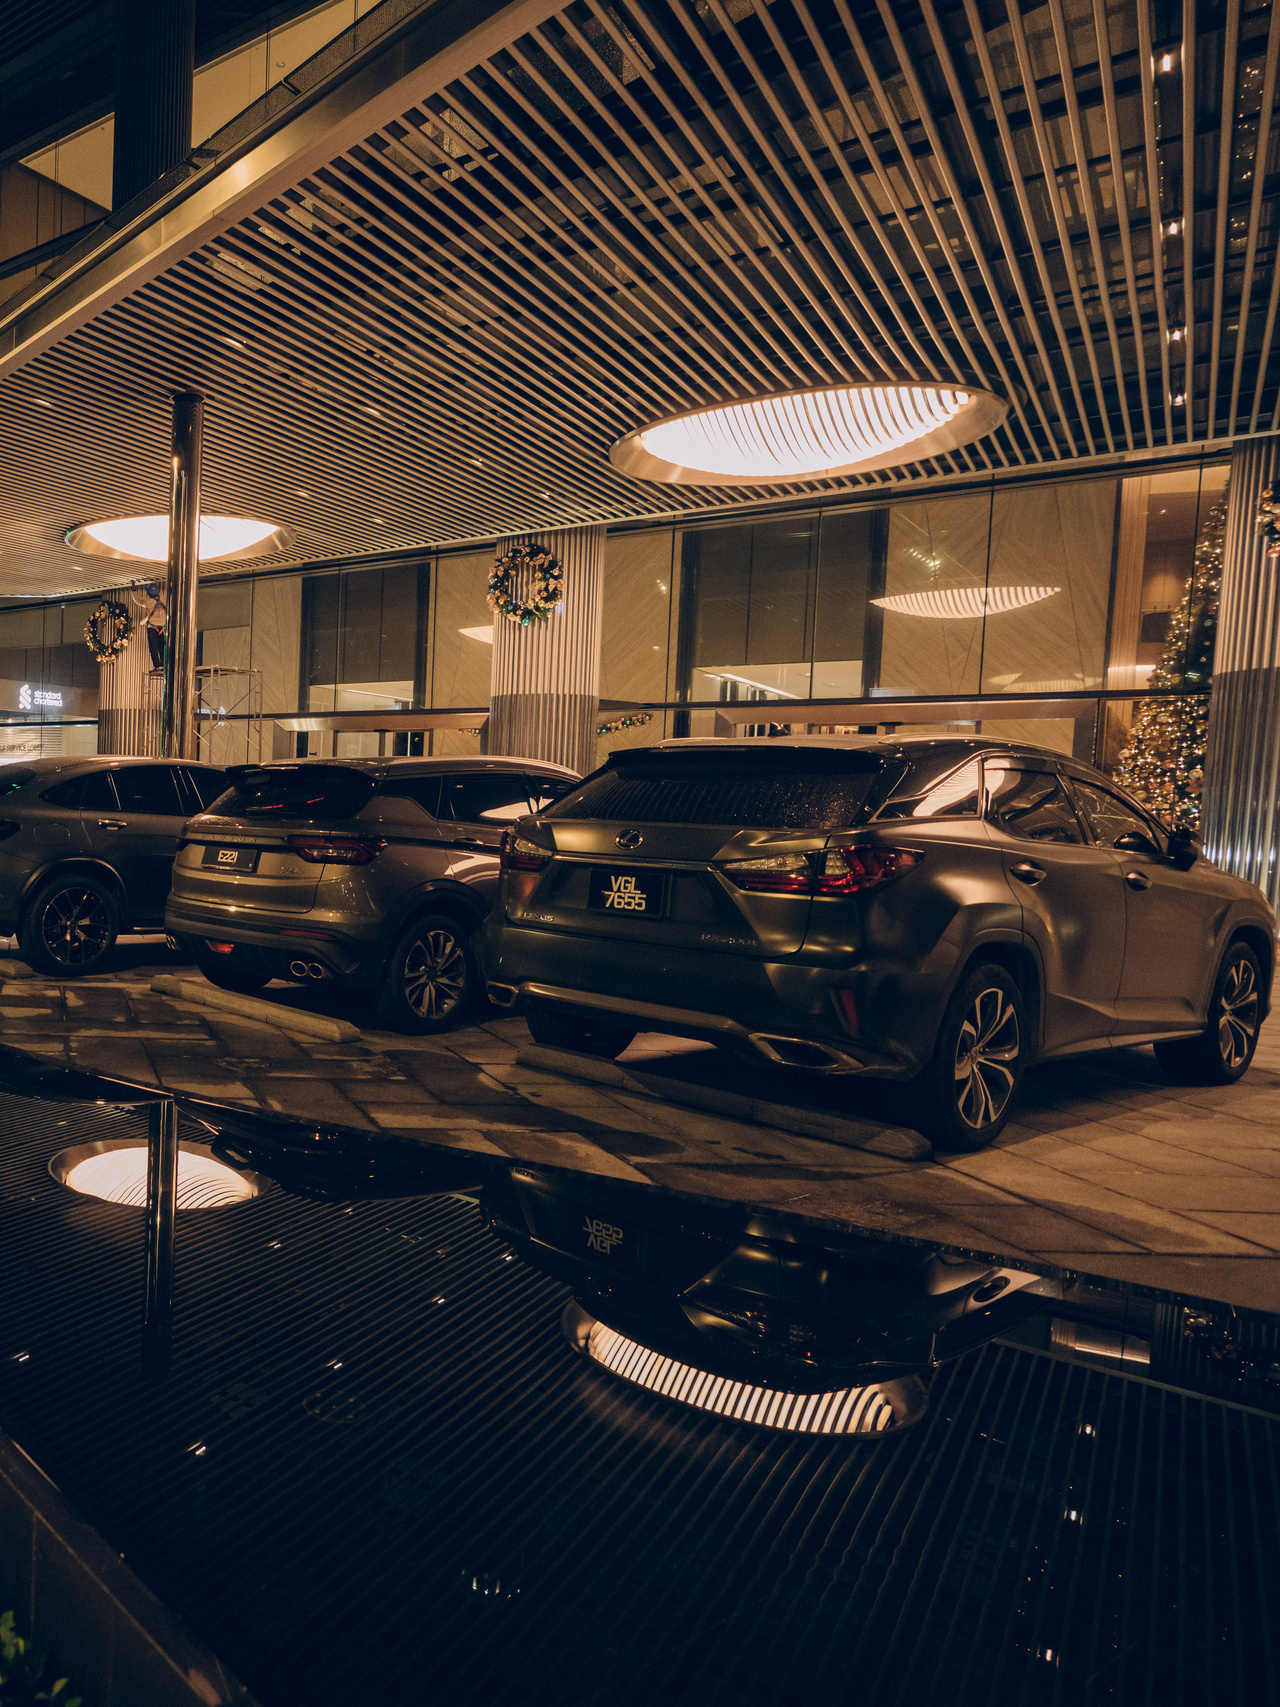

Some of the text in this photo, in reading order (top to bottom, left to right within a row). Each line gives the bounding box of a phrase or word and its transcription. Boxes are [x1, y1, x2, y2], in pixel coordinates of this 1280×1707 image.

[611, 875, 641, 894] VGL
[604, 891, 647, 911] 7655
[523, 912, 554, 922] LEXUS
